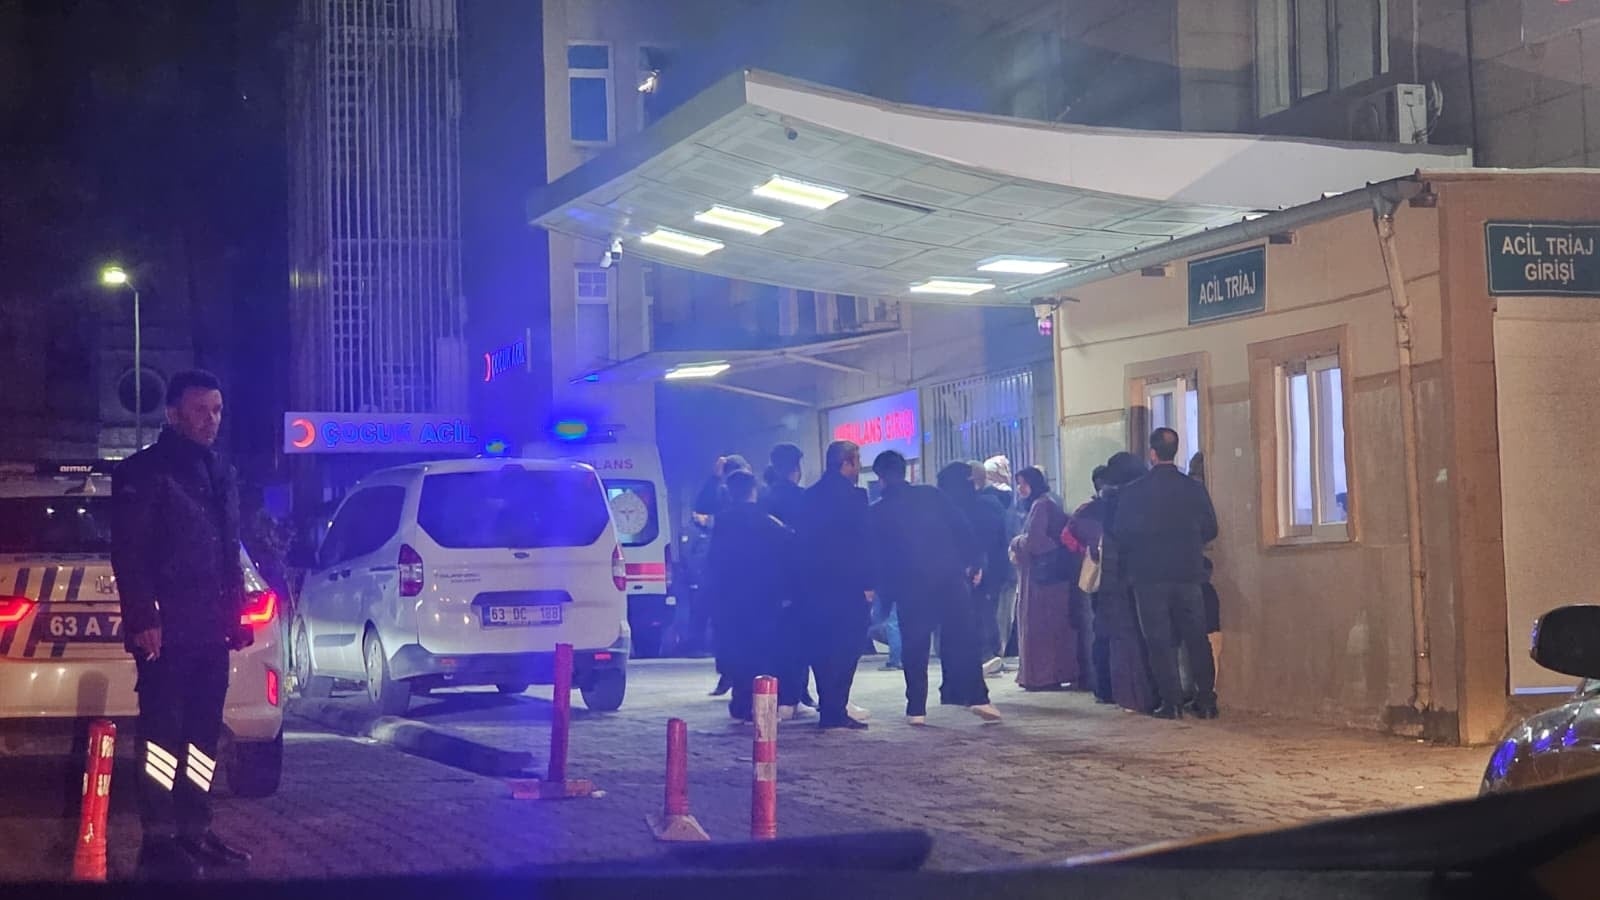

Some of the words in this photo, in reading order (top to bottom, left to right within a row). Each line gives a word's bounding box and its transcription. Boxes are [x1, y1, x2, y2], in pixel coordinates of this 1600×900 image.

[1501, 232, 1542, 256] ACİL
[1545, 233, 1594, 256] TRİAJ
[1524, 258, 1575, 285] GİRİŞİ
[1199, 275, 1224, 305] ACİL
[1225, 268, 1256, 299] TRİAJ
[419, 418, 478, 444] ACİL
[593, 458, 633, 470] LANS
[491, 607, 505, 620] 63
[512, 607, 527, 620] DC
[50, 616, 77, 636] 63
[84, 616, 101, 636] A
[108, 616, 122, 636] 7
